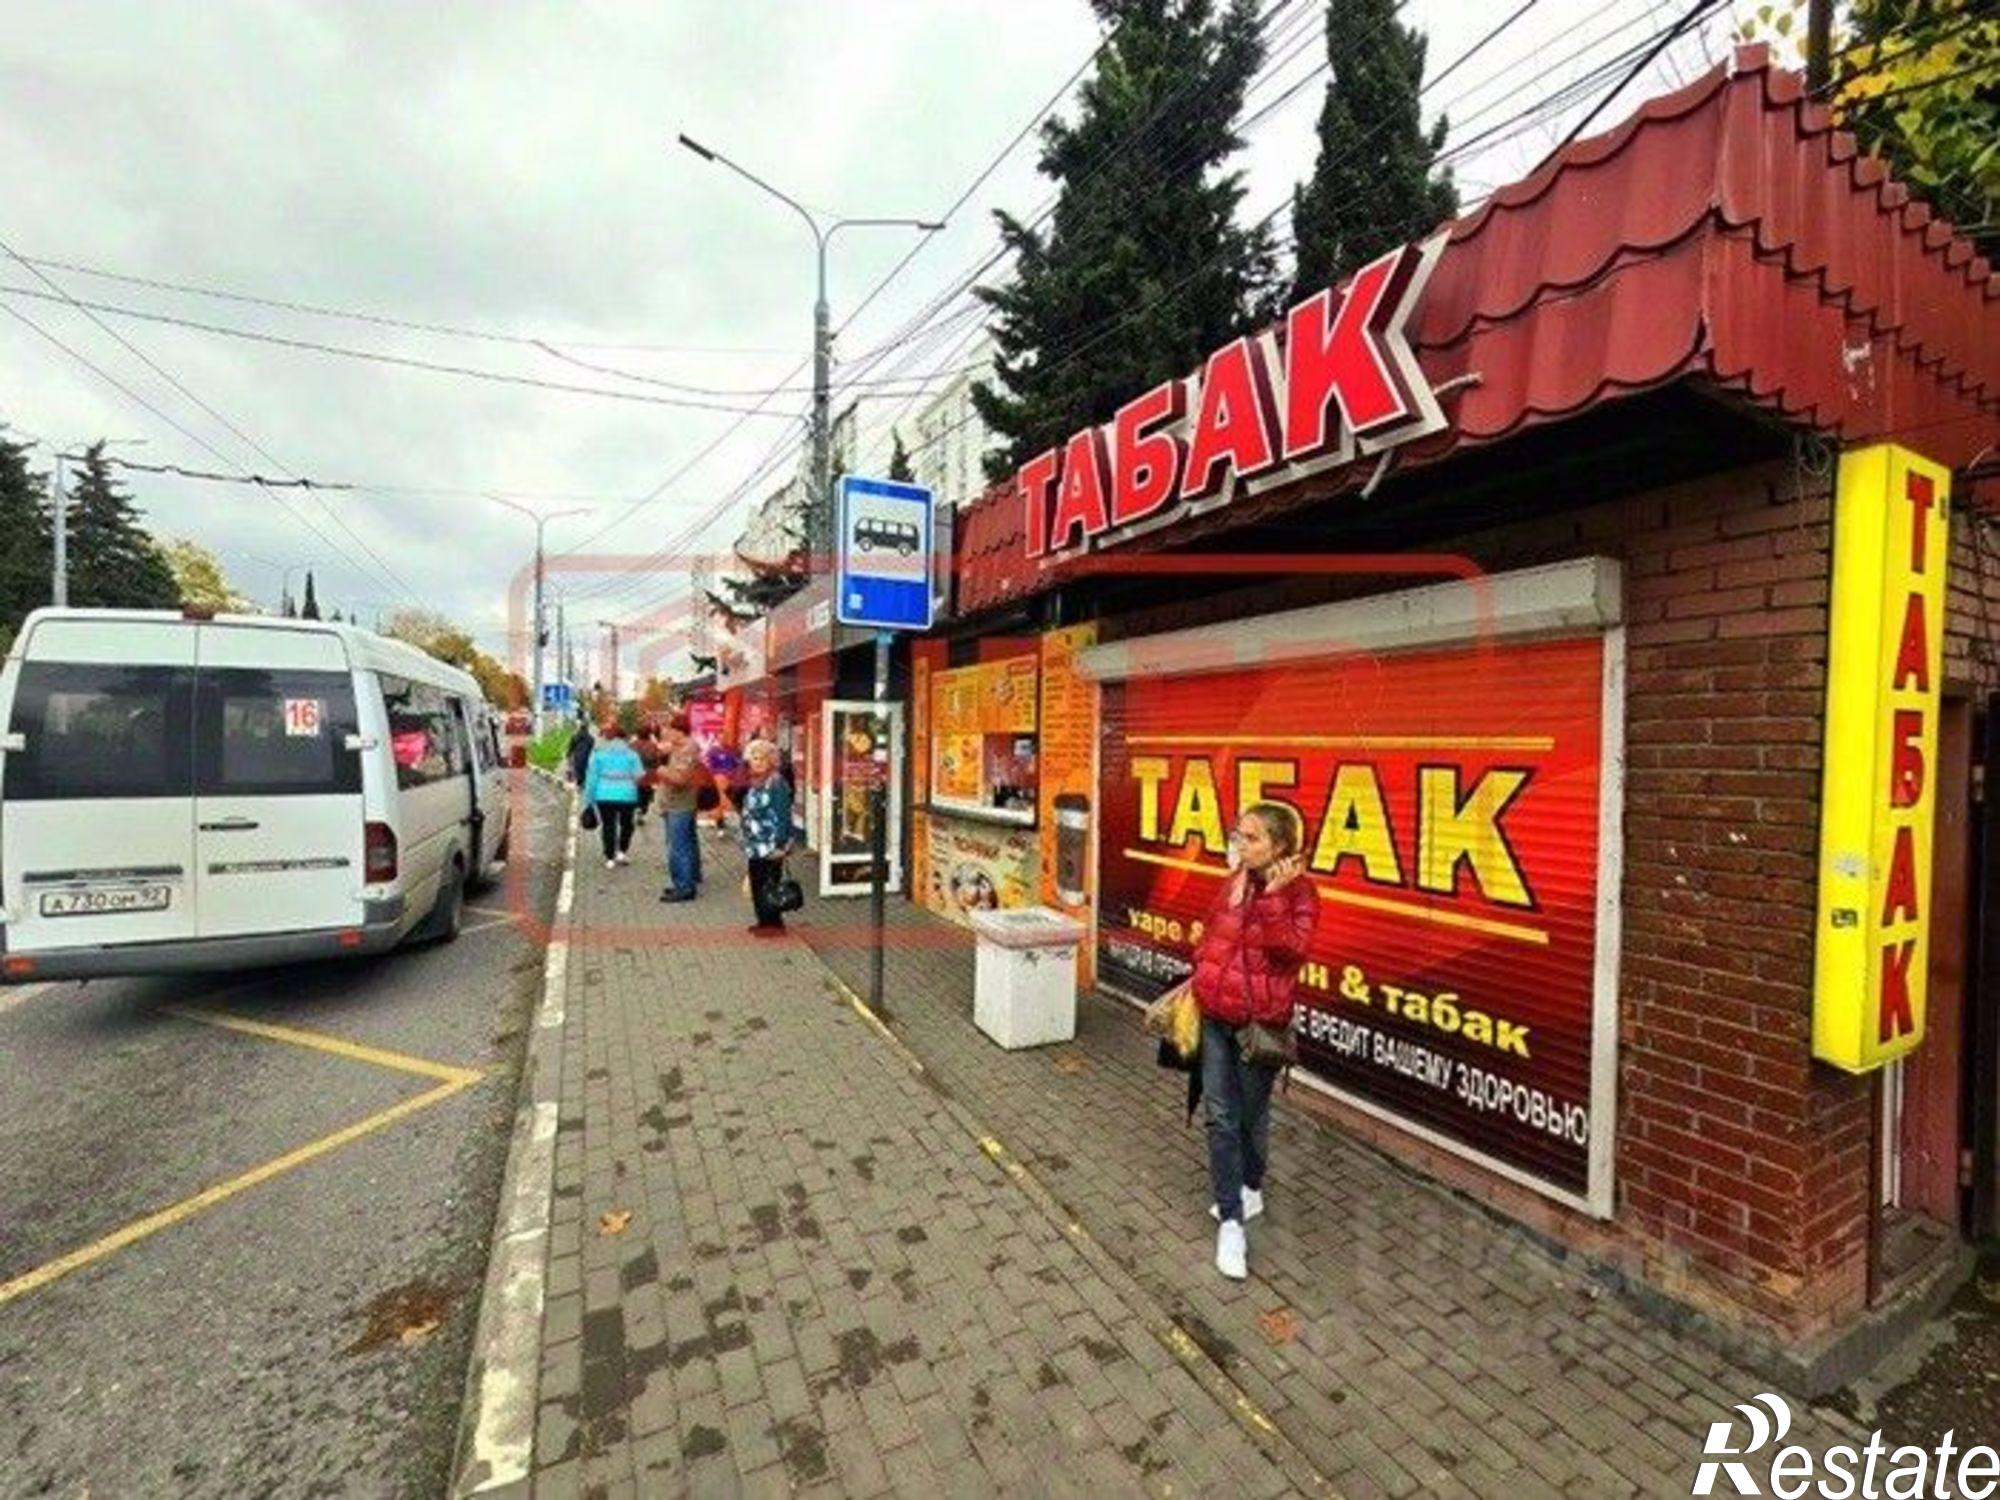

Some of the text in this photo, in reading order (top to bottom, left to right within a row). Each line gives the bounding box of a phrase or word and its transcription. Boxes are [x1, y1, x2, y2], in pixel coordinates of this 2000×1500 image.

[1018, 243, 1412, 562] ТАБАК
[290, 702, 315, 728] 16
[1878, 469, 1935, 1044] ТАБАК
[1310, 1008, 1370, 1058] ВРЕДИТ
[1373, 1033, 1451, 1090] ВАШЕМУ
[1456, 1062, 1590, 1146] ЗДОРОВЬЮ
[1339, 964, 1371, 1005] &
[1379, 984, 1532, 1058] табак
